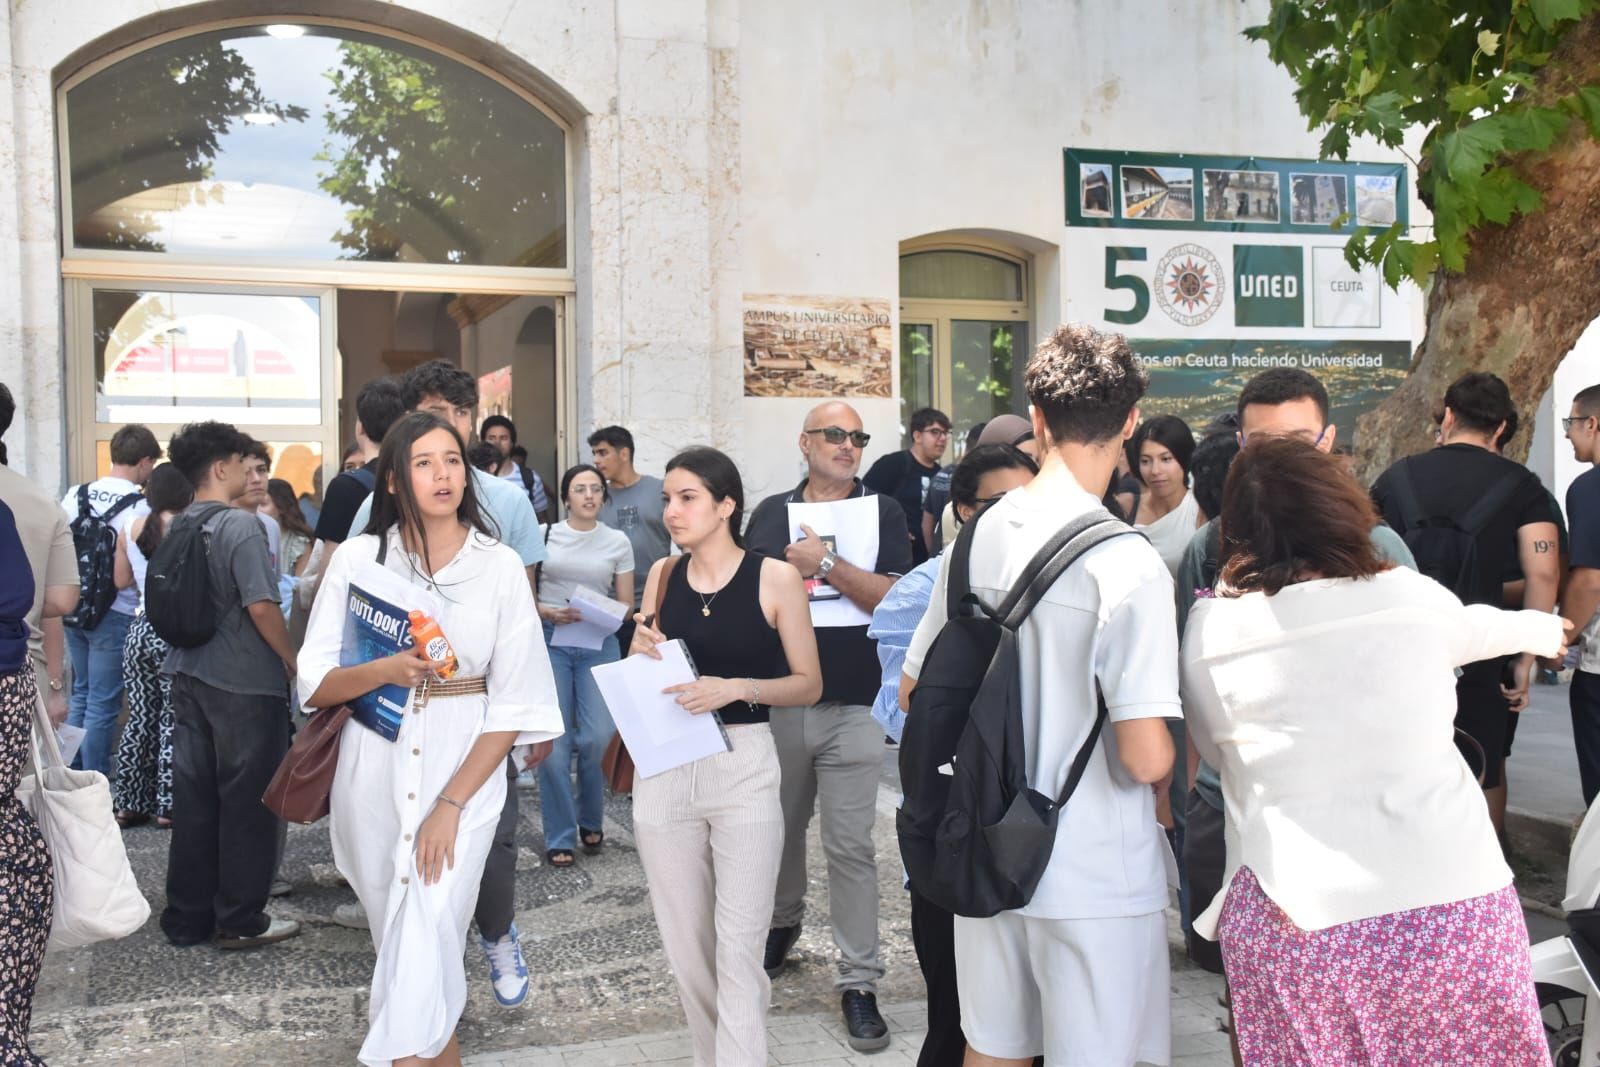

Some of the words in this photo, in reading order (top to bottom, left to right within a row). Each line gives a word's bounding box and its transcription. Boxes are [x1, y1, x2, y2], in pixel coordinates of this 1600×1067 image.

[1239, 274, 1299, 299] UNED
[1330, 280, 1364, 293] CEUTA
[743, 309, 791, 323] AMPUS
[793, 310, 890, 325] UNIVERSITARIO
[1130, 353, 1160, 367] ños
[1163, 355, 1182, 367] en
[1185, 353, 1228, 367] Ceuta
[1232, 353, 1298, 368] haciendo
[1301, 353, 1383, 368] Universidad
[349, 595, 402, 637] OUTLOOK
